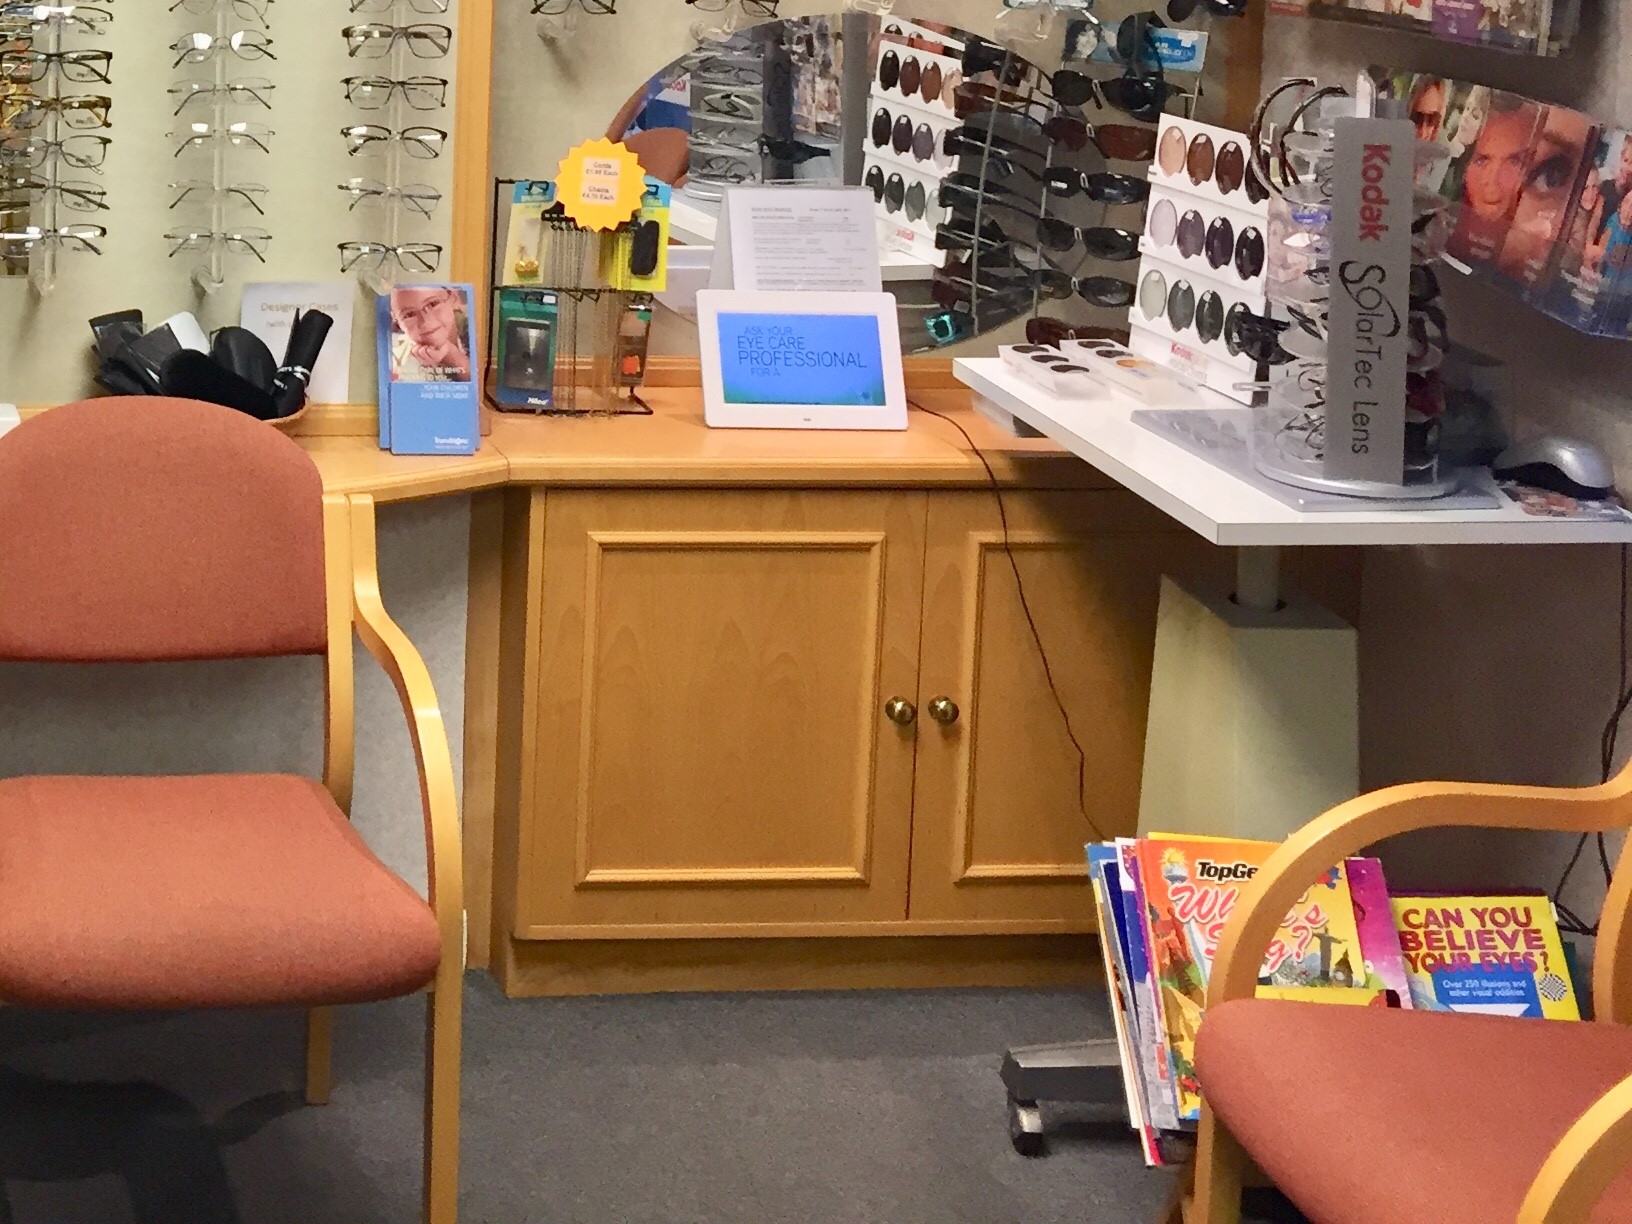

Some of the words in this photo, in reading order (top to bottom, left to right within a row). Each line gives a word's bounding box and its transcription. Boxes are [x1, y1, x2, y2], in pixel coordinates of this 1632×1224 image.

[1358, 143, 1393, 242] Kodak
[260, 302, 305, 313] Designer
[309, 302, 339, 311] Cases
[744, 326, 764, 335] ASK
[768, 326, 793, 336] YOUR
[737, 335, 765, 350] EYE
[768, 336, 806, 350] CARE
[738, 350, 867, 368] PROFESSIONAL
[1352, 401, 1379, 456] Lens
[1197, 862, 1258, 881] TopGe
[1402, 908, 1465, 929] CAN
[1470, 907, 1533, 928] YOU
[1399, 928, 1546, 951] BELIEVE
[1404, 951, 1473, 974] YOUR
[1478, 951, 1550, 973] EYES?
[1443, 979, 1463, 988] Over
